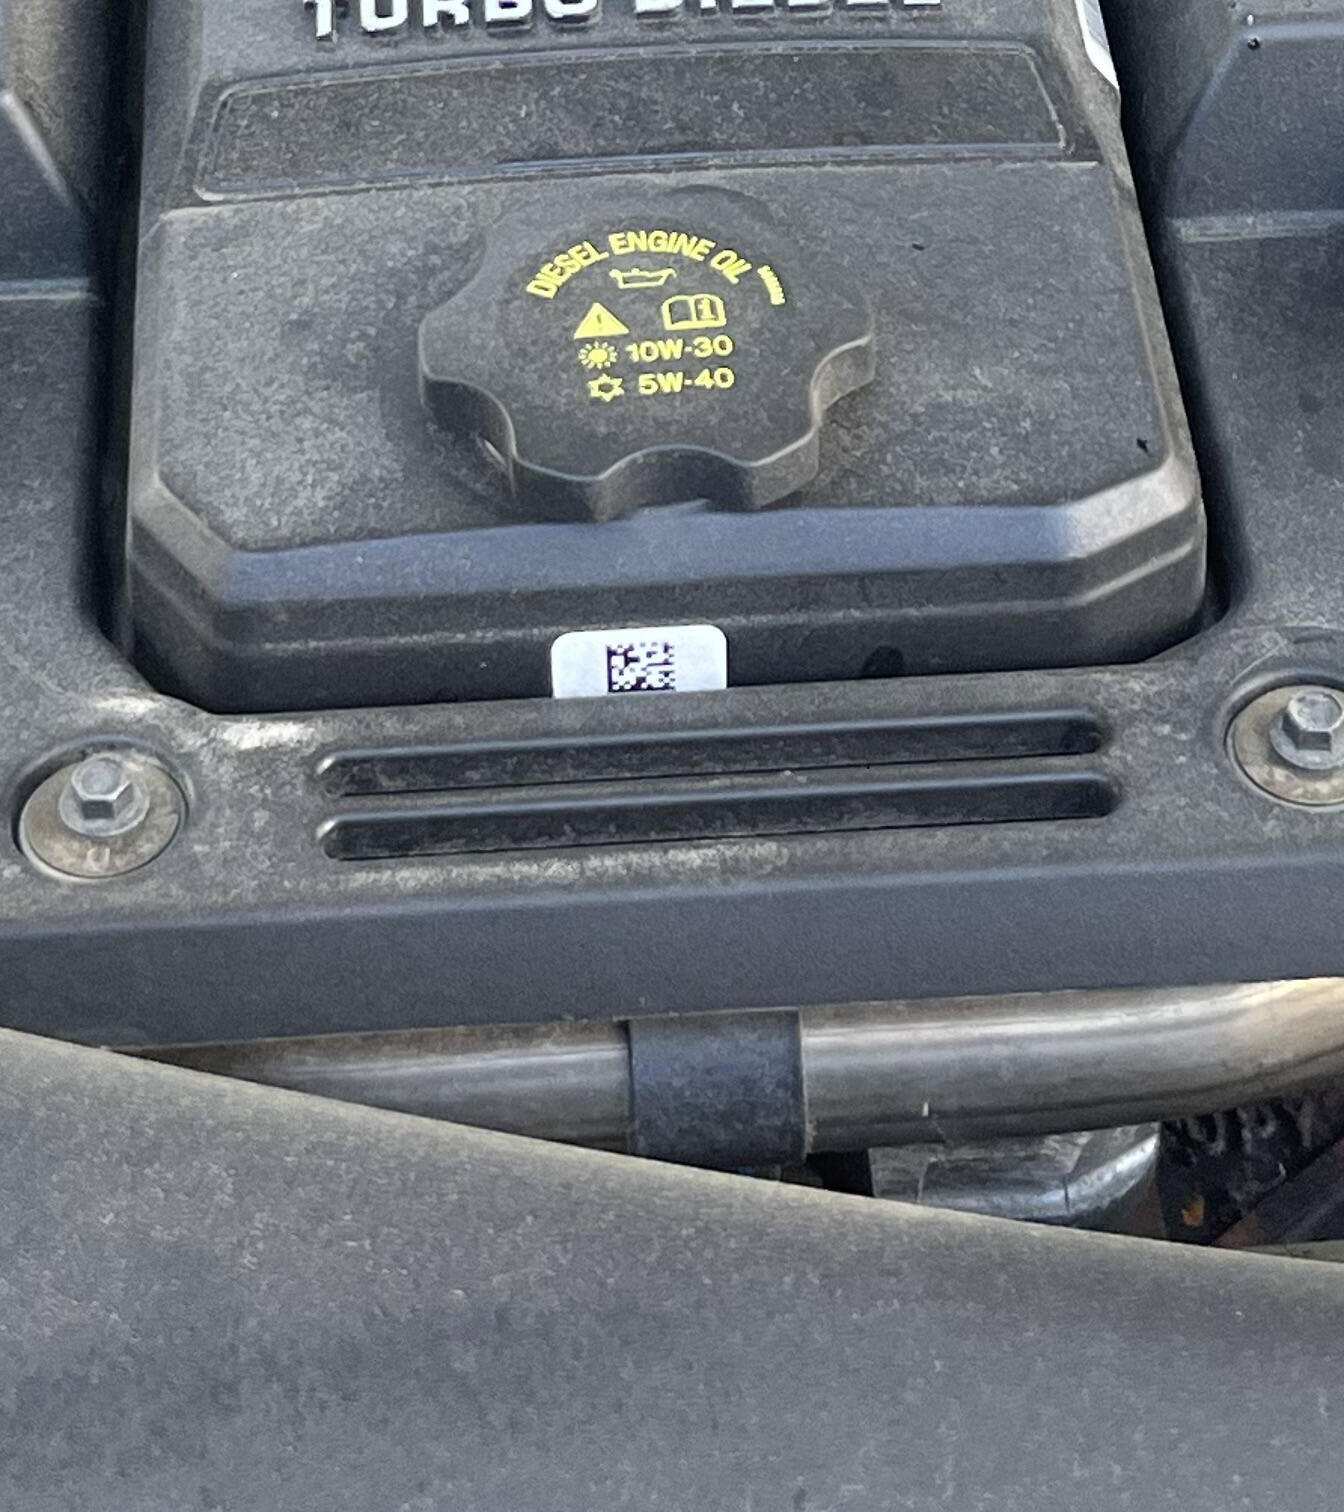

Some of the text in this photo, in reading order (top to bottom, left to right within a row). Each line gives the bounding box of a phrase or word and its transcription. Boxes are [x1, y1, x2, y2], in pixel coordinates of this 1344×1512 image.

[525, 229, 753, 299] DIESEL ENGINE OIL
[625, 334, 734, 363] 10W-30
[637, 366, 735, 395] 5W-40
